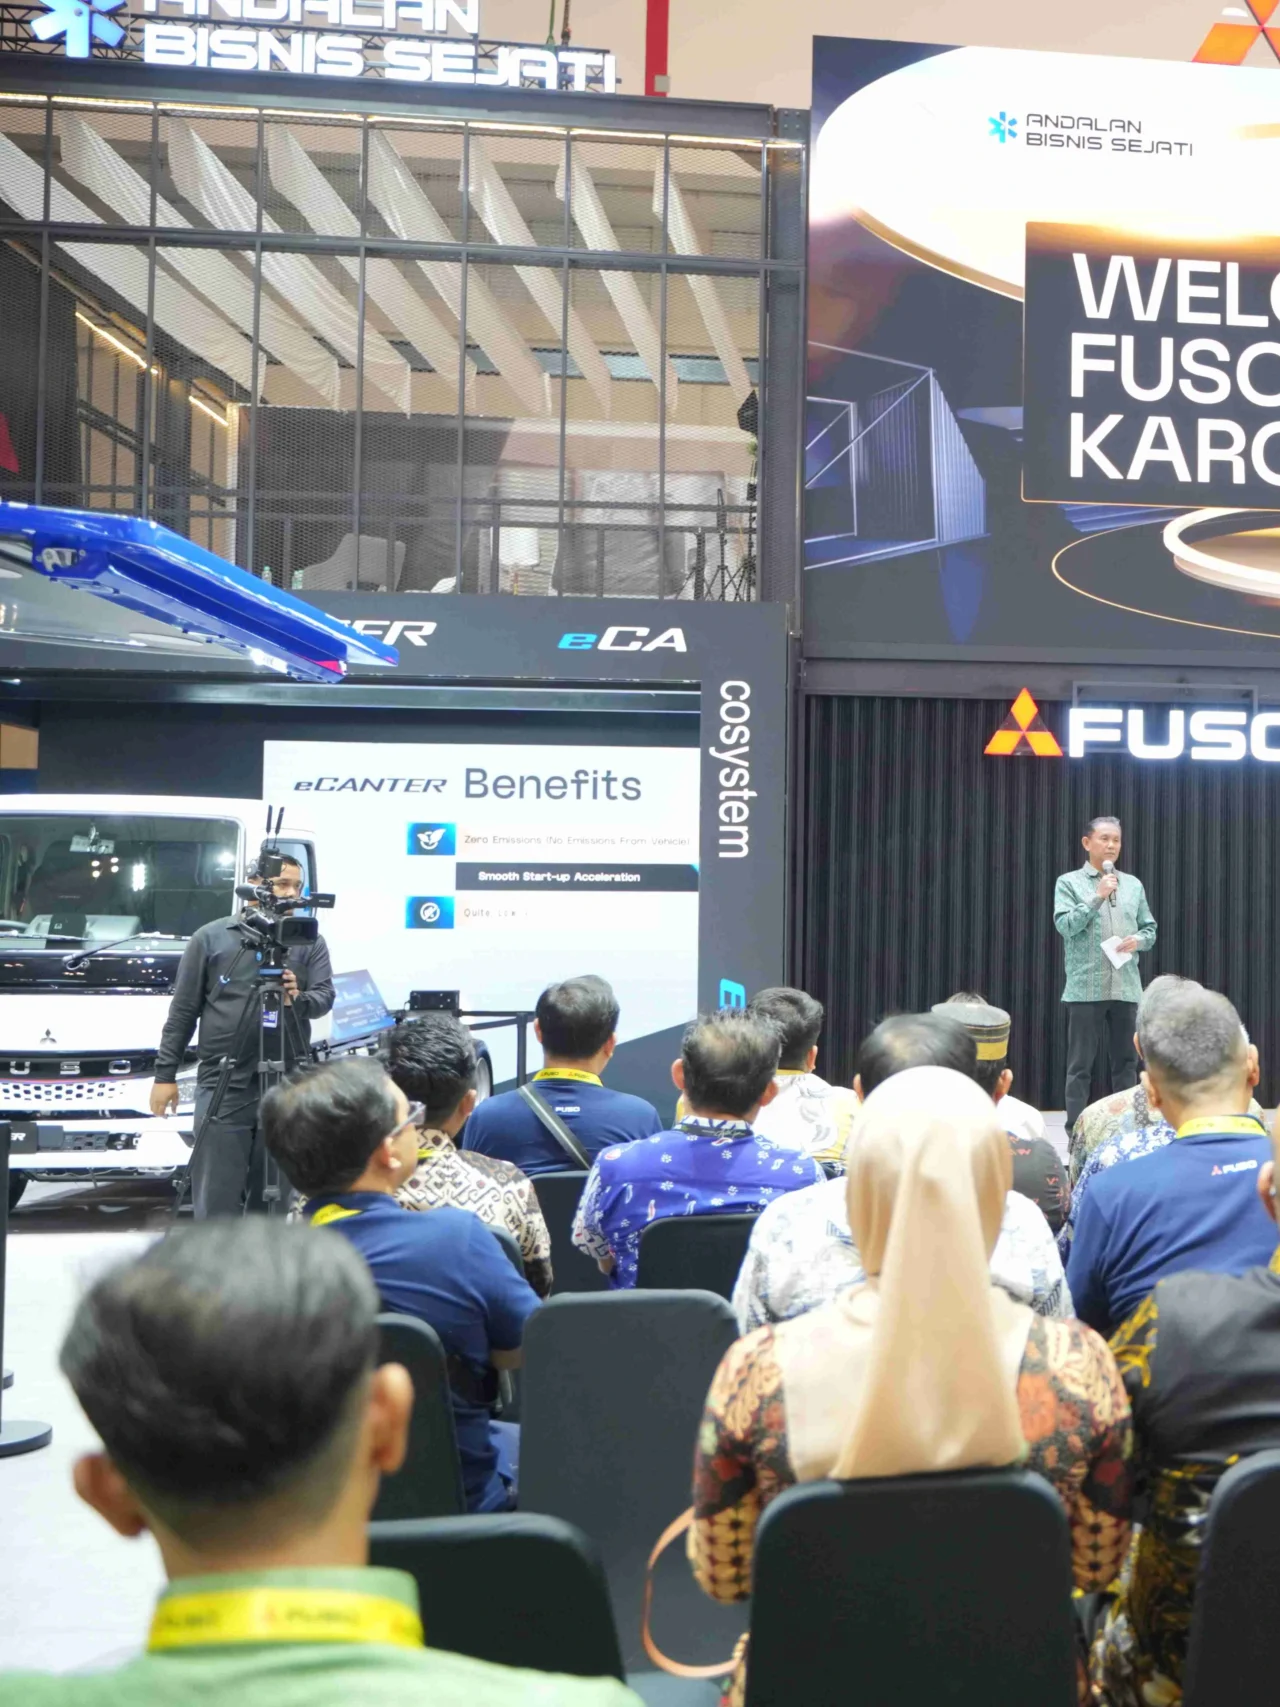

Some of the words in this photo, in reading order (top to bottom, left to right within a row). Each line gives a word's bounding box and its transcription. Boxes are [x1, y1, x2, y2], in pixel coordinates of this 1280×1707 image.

[143, 23, 365, 78] BISNIS
[382, 40, 617, 94] SEJATI
[1025, 113, 1142, 134] ANDALAN
[1025, 132, 1103, 150] BISNIS
[1111, 138, 1193, 156] SEJATI
[558, 626, 687, 652] eCA
[709, 680, 757, 858] cosystem
[293, 777, 447, 793] eCANTER
[465, 767, 642, 801] Benefits
[464, 835, 489, 844] Zero
[492, 835, 542, 845] Emissions
[567, 836, 616, 846] Emissions
[478, 871, 520, 881] Smooth
[522, 871, 571, 883] Start-up
[574, 872, 641, 882] Acceleration
[1222, 1159, 1258, 1175] FUSO
